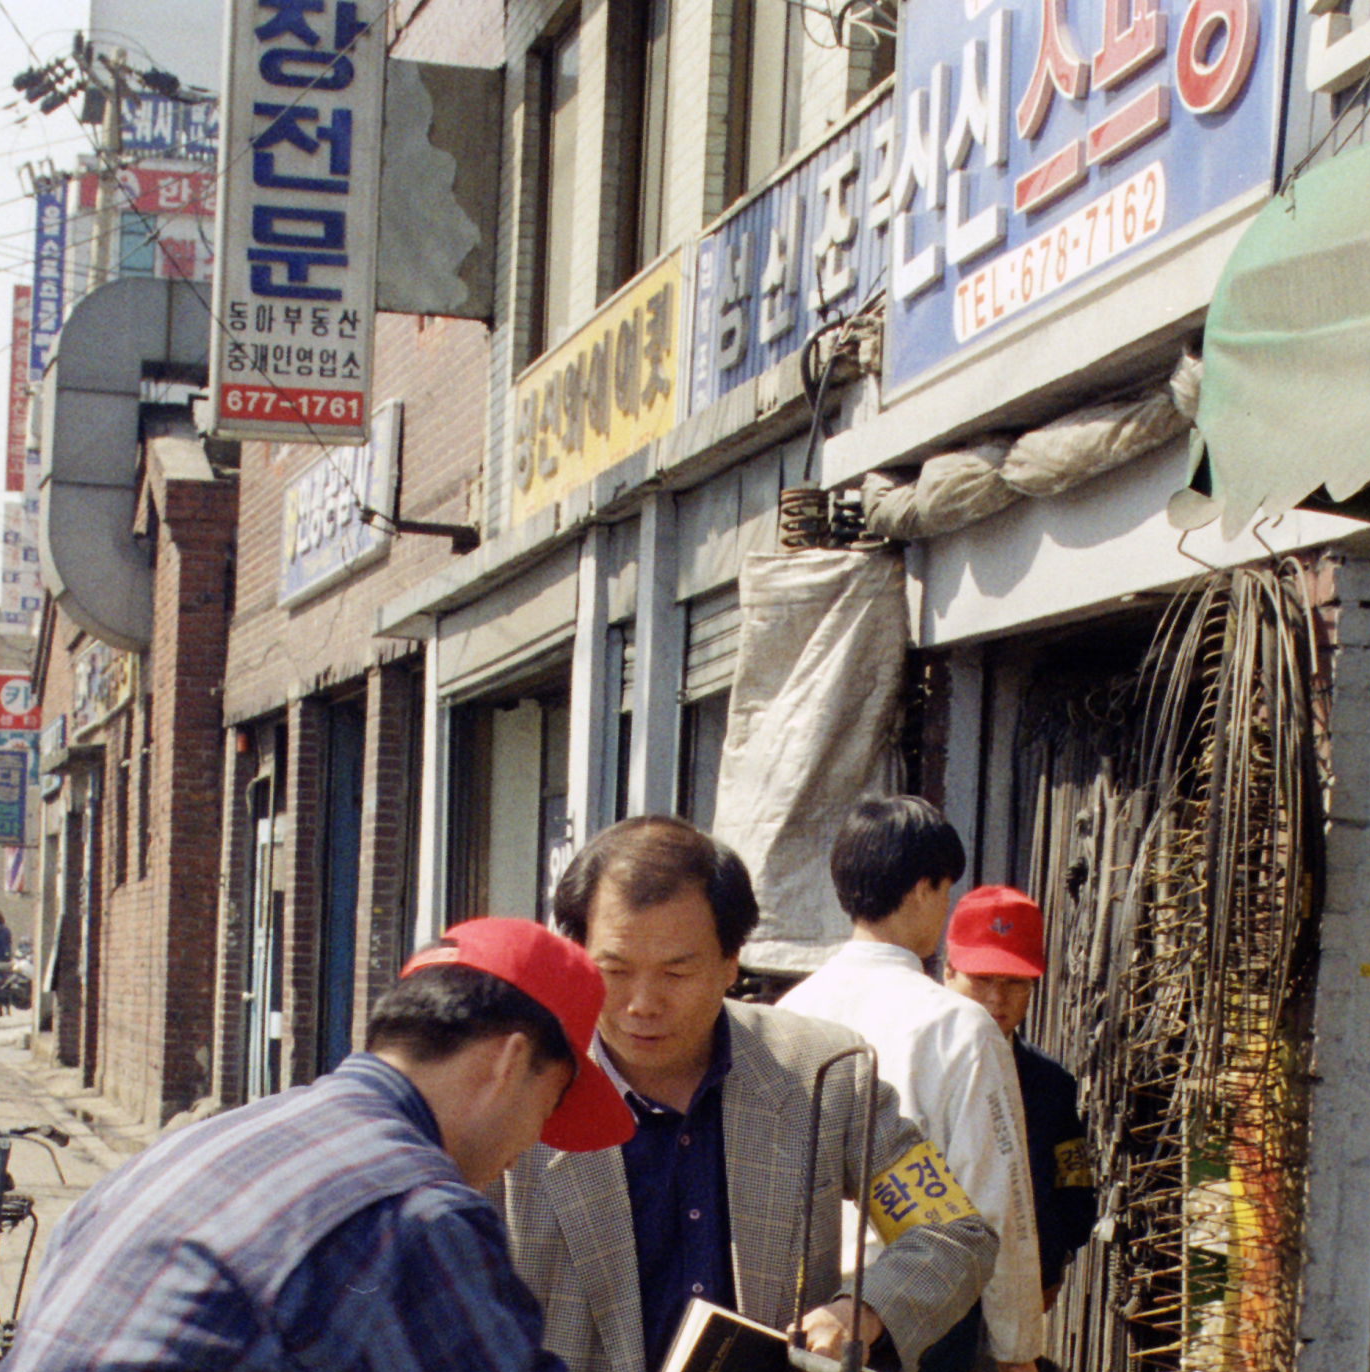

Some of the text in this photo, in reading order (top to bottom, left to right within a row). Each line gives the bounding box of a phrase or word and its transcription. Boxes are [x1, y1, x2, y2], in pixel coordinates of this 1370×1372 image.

[229, 301, 361, 339] 동아부동산
[228, 342, 361, 380] 중개인영업소
[226, 389, 360, 419] 677-1761
